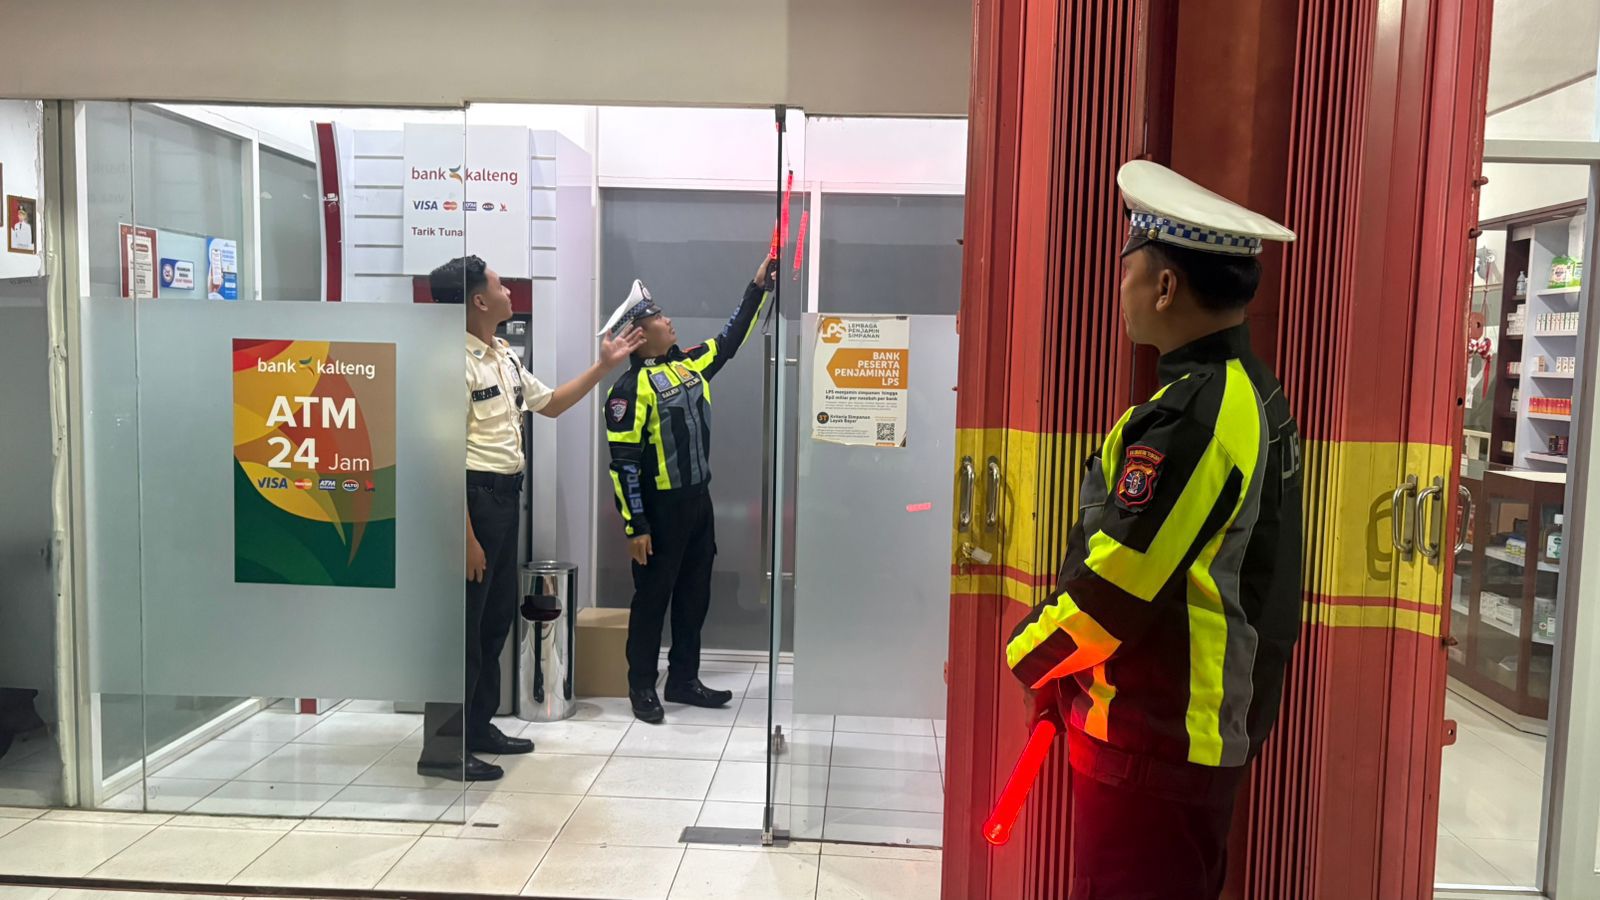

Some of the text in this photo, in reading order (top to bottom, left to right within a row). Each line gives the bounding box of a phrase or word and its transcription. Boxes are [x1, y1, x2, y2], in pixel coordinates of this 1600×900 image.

[412, 166, 518, 185] bank kalteng
[413, 200, 438, 210] VISA
[412, 226, 464, 236] Tarik Tuna
[873, 352, 900, 360] BANK
[257, 358, 376, 380] bank kalteng
[858, 360, 900, 369] PESERTA
[834, 368, 900, 378] PENJAMINAN
[882, 378, 900, 386] LPS
[266, 395, 356, 430] ATM
[267, 437, 370, 472] 24 Jam
[257, 477, 288, 490] VISA
[623, 464, 644, 513] POLISI
